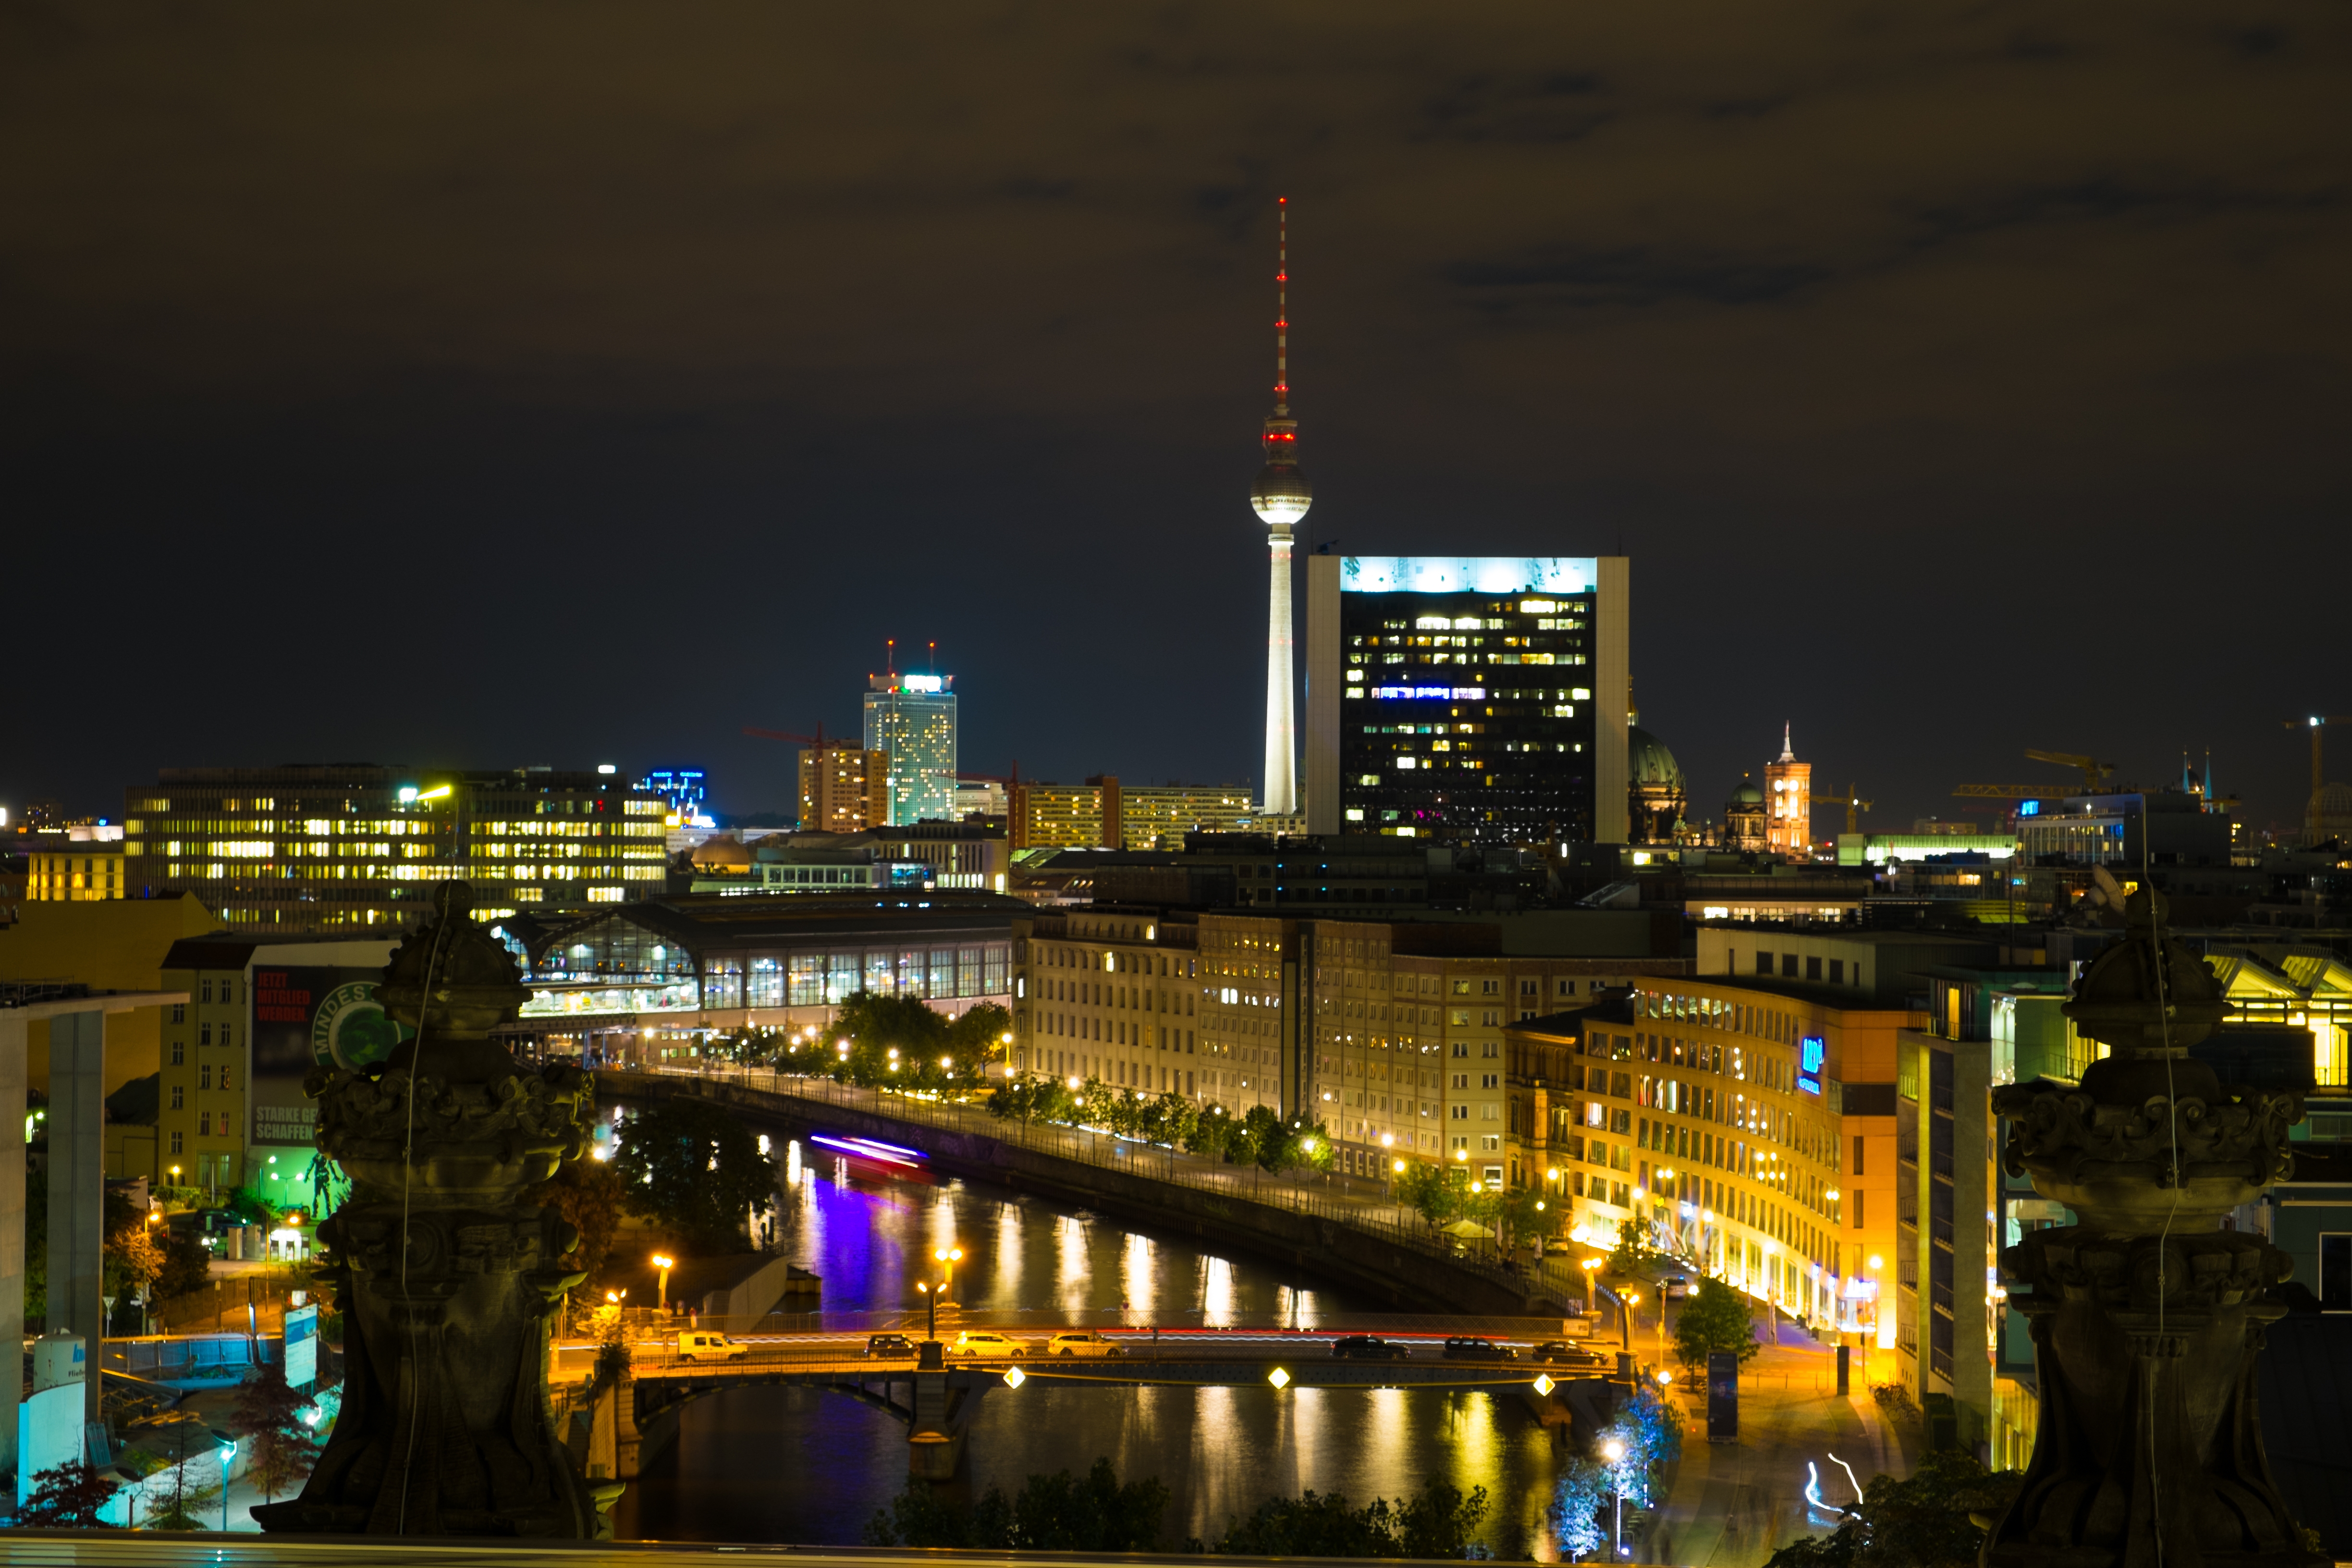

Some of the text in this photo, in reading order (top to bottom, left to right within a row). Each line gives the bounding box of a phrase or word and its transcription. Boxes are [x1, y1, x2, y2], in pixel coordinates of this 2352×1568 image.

[258, 972, 287, 988] JETZT
[257, 989, 310, 1005] MITGLIED
[257, 1006, 308, 1022] WERDEN.
[315, 985, 374, 1054] MINDES
[256, 1106, 299, 1122] STARKE
[256, 1122, 313, 1140] SCHAFFEN
